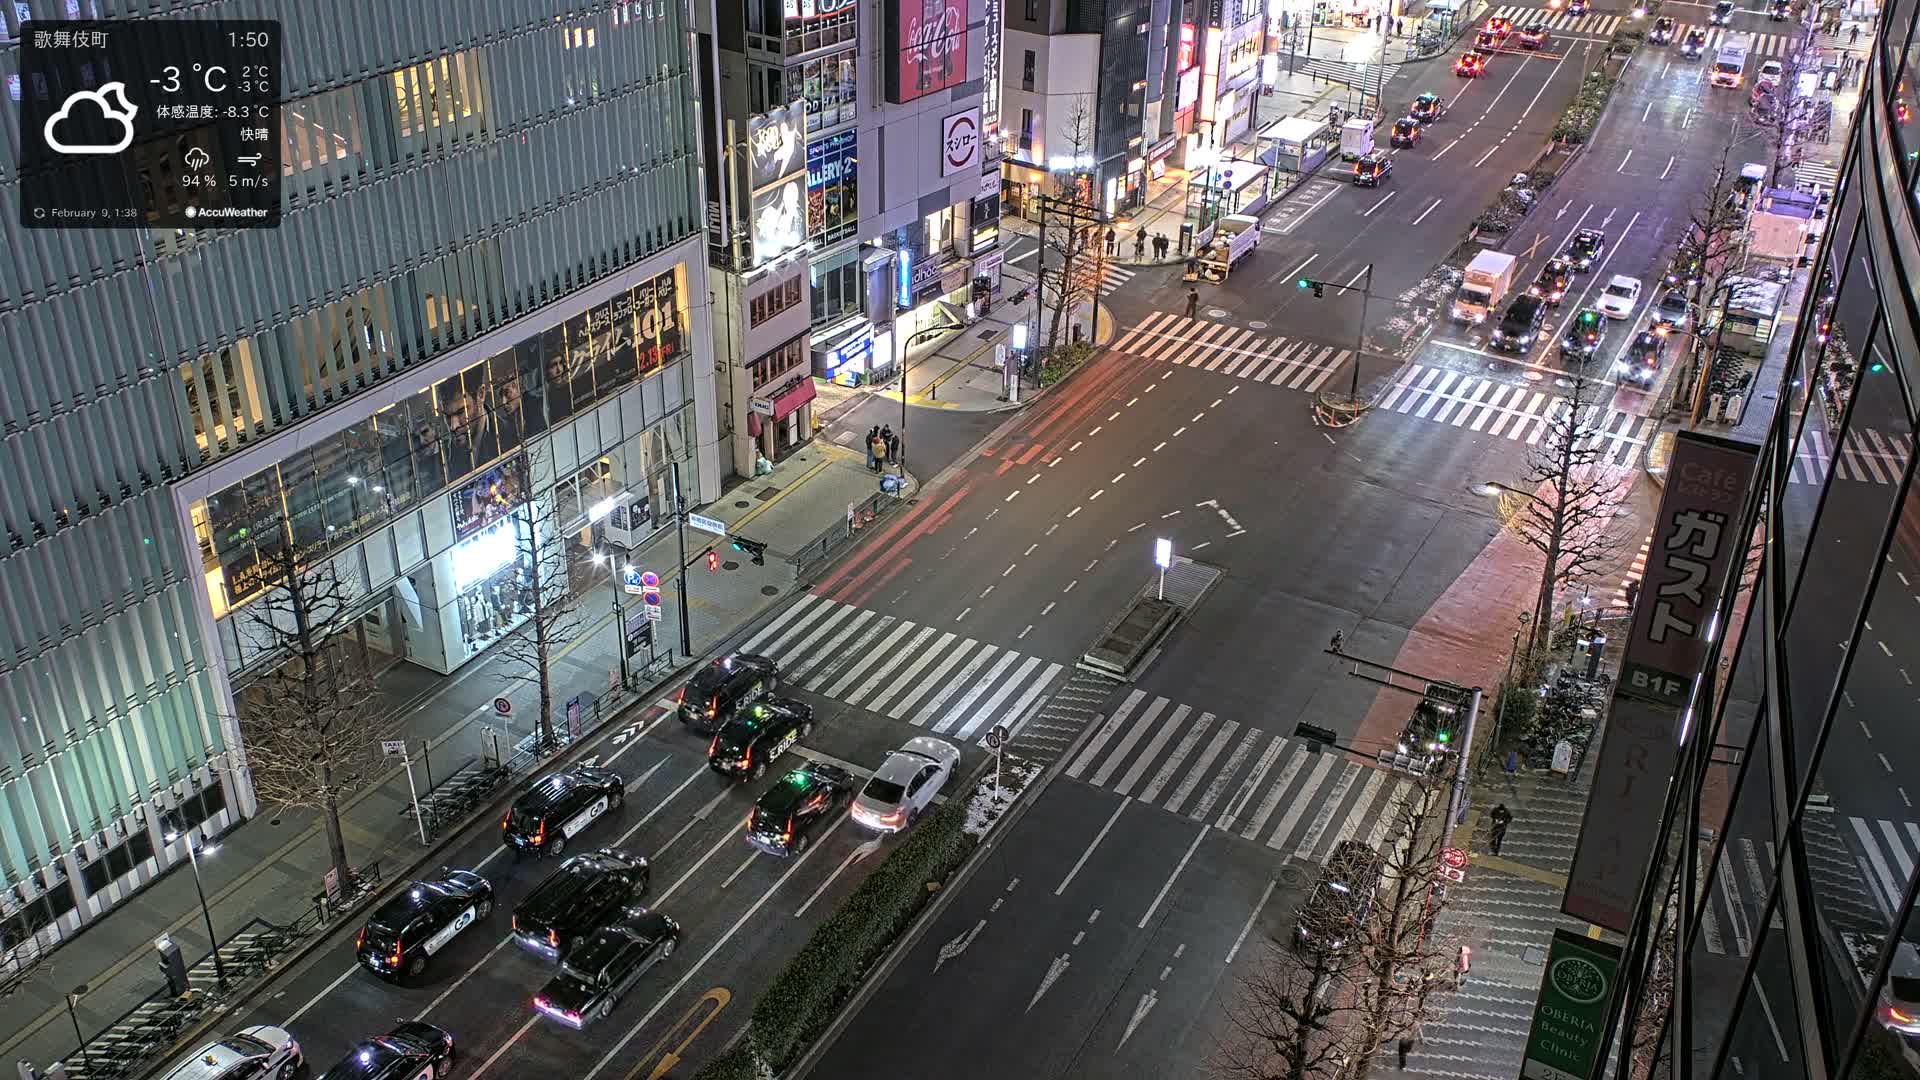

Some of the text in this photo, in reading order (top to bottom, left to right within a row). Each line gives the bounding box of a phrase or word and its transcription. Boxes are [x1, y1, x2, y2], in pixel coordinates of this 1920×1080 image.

[906, 6, 960, 64] Coca-Cola
[946, 134, 977, 153] スシロー
[708, 201, 721, 234] MUJI
[827, 224, 856, 241] BASKETBALL
[632, 301, 675, 348] 101
[1646, 508, 1728, 645] ガスト
[1631, 671, 1681, 697] B1F
[768, 734, 798, 763] S.RIDE
[1541, 1005, 1595, 1033] OBERIA
[1541, 1021, 1590, 1047] Beauty
[1540, 1040, 1582, 1061] Clinic
